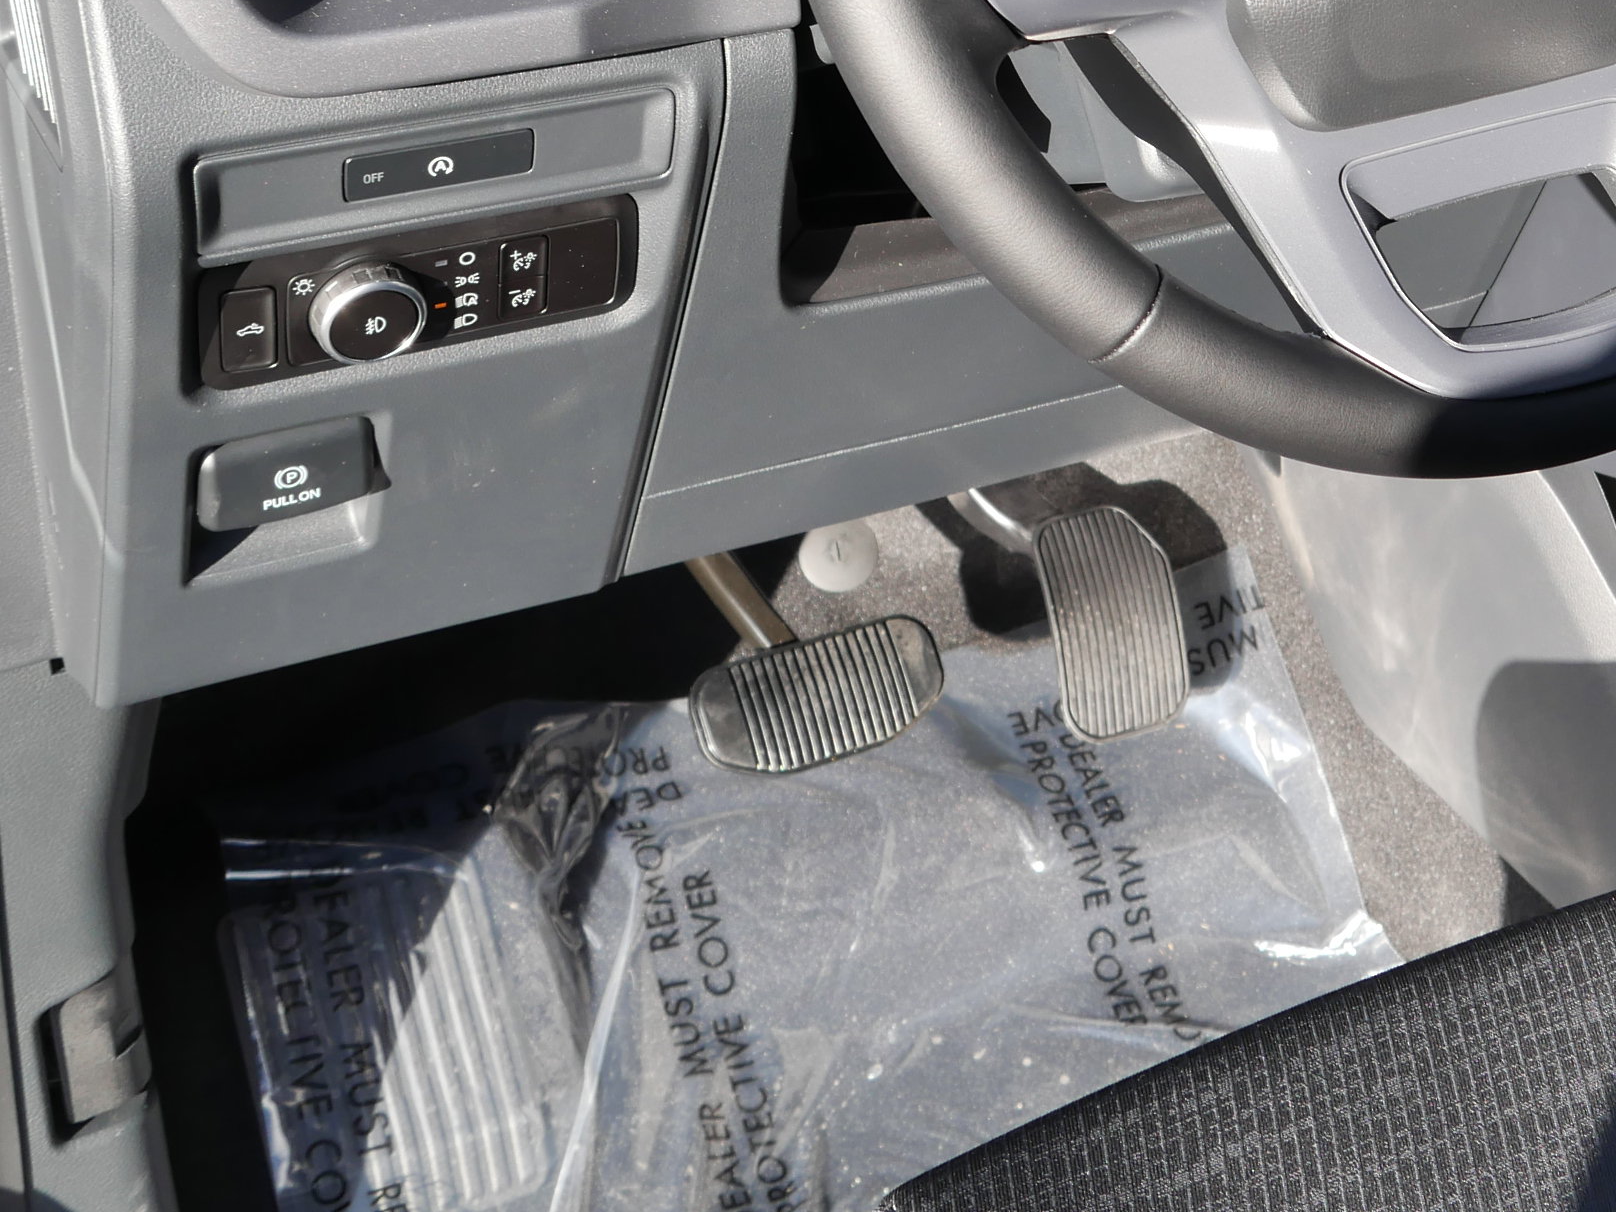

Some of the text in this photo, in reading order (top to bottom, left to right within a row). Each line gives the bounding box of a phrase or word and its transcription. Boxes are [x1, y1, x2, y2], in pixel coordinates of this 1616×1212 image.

[363, 170, 385, 185] OFF
[263, 487, 321, 511] PULL ON
[1187, 625, 1258, 677] MUS
[1019, 739, 1111, 912] PROTECTIVE
[1059, 733, 1125, 828] DEALER
[1111, 844, 1156, 945] MUST
[683, 869, 736, 997] COVER
[616, 818, 751, 1212] EALER MUST REMOVE
[339, 1041, 394, 1157] MUST
